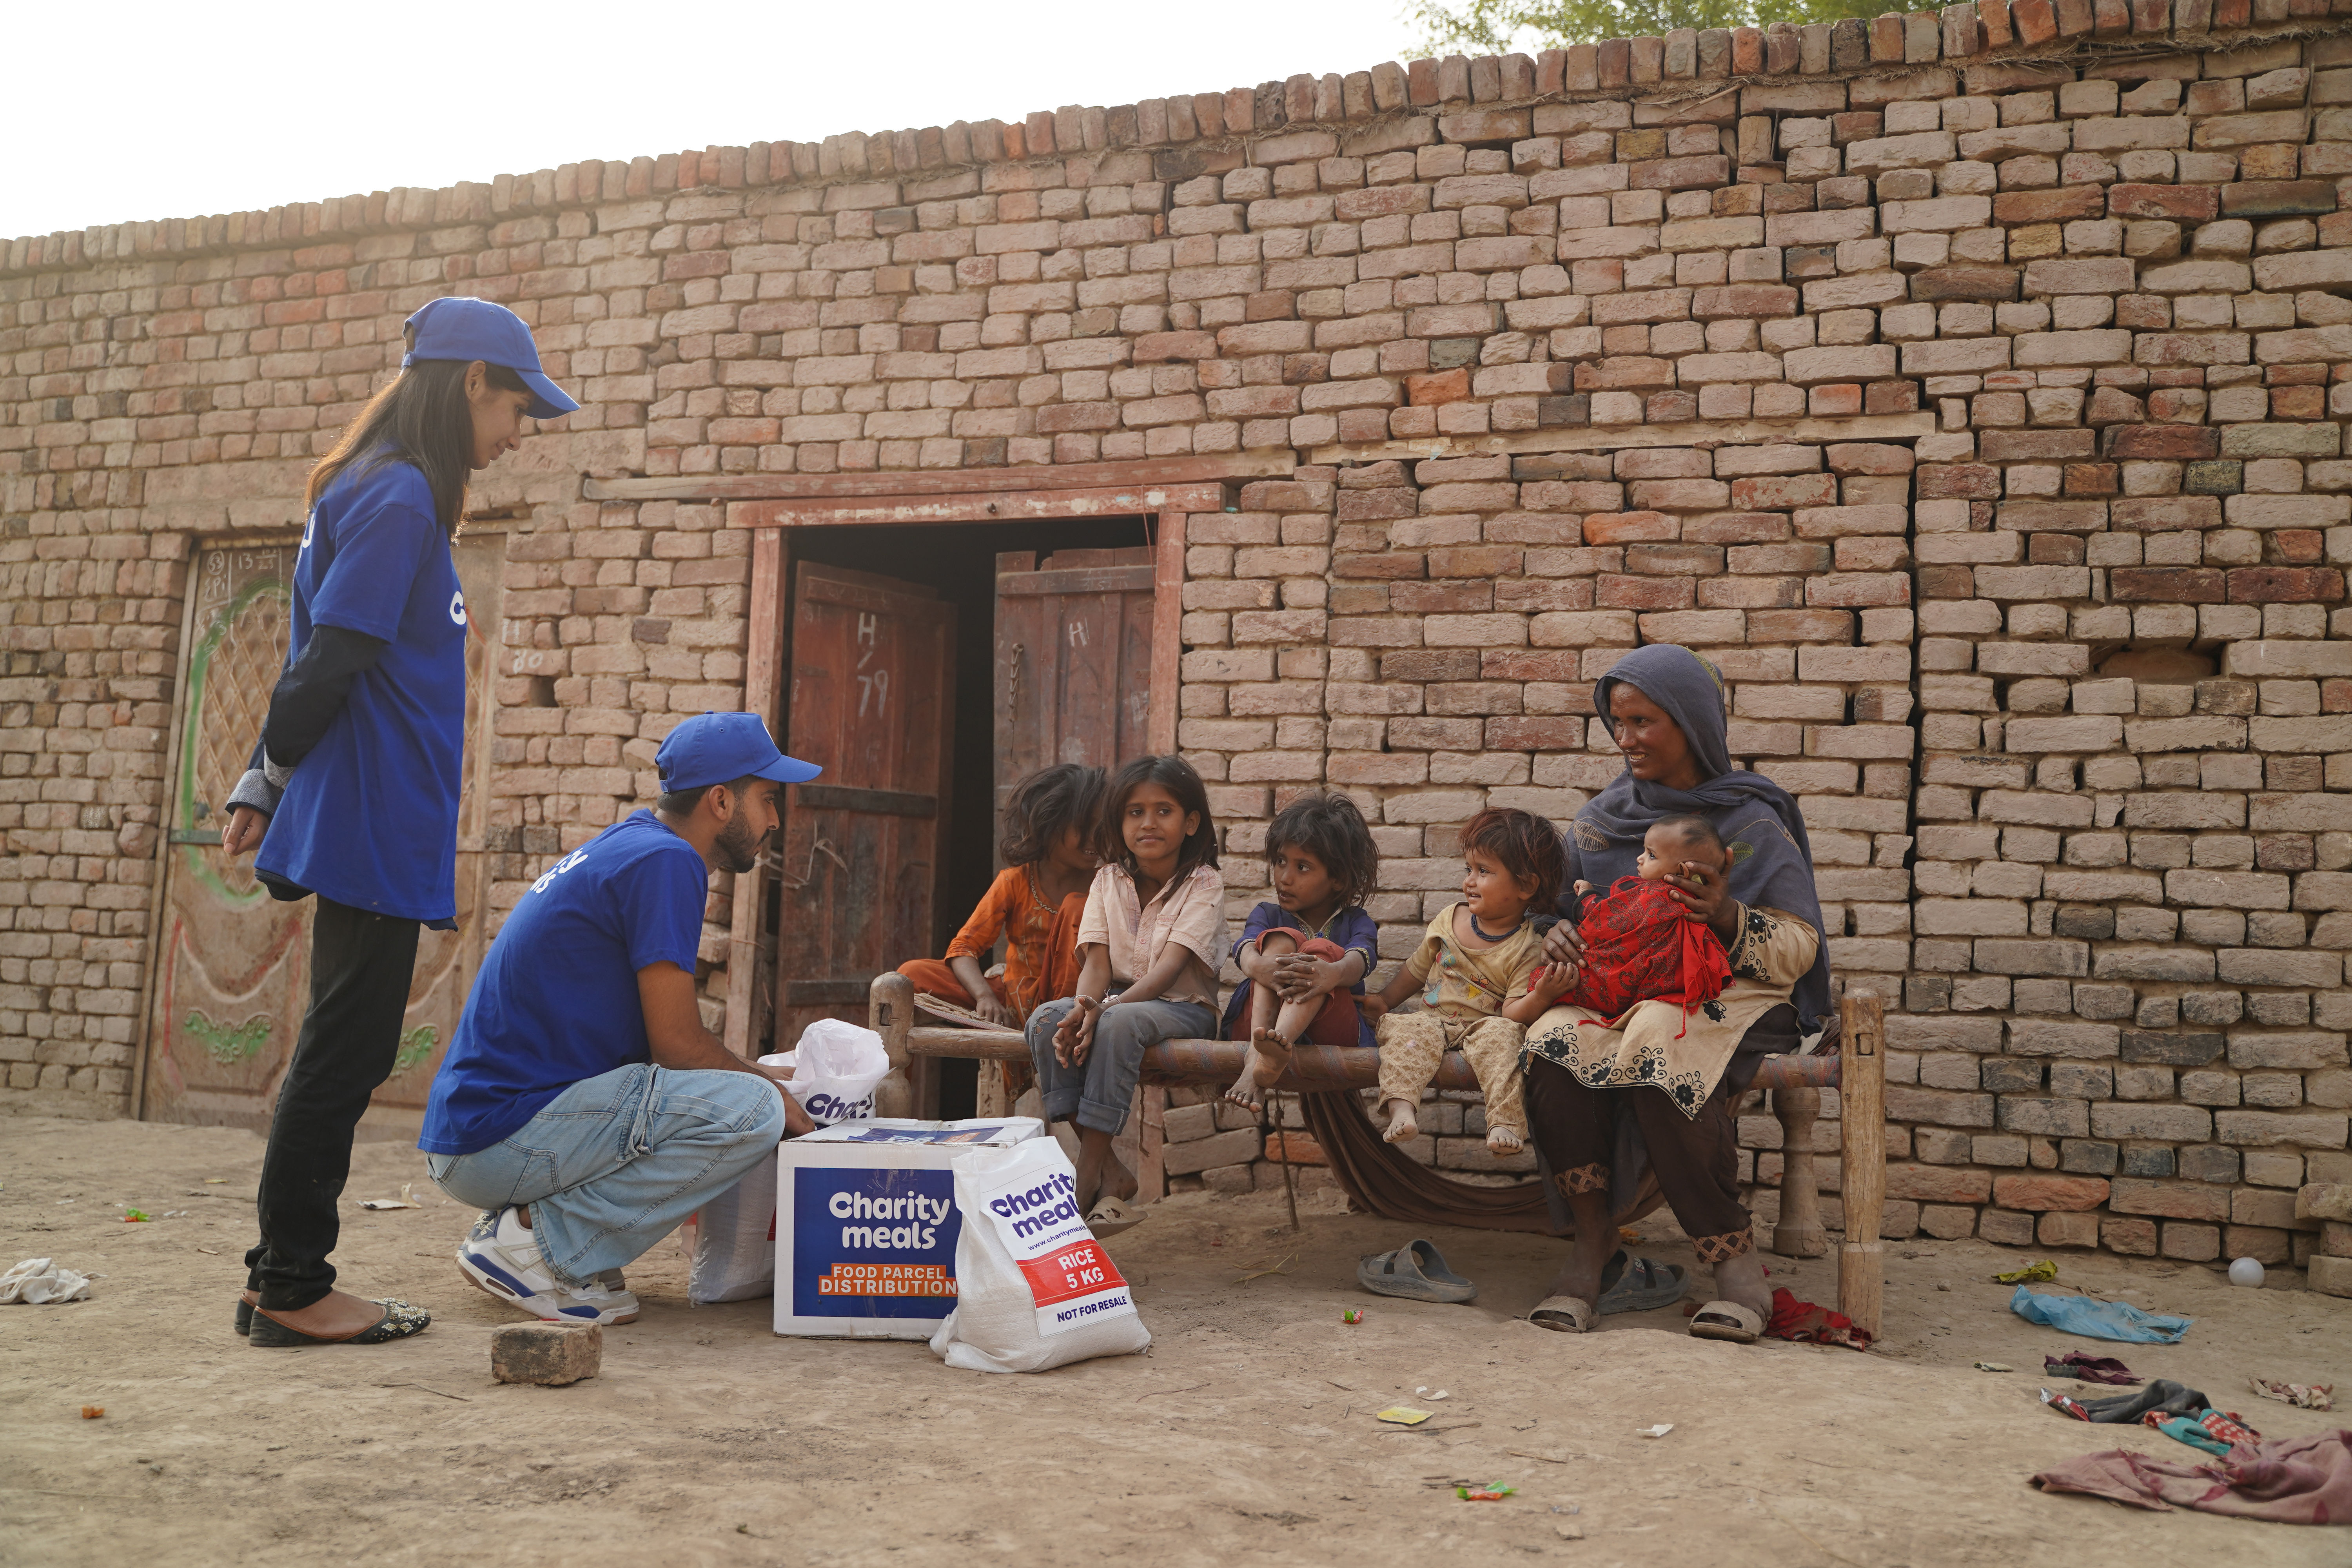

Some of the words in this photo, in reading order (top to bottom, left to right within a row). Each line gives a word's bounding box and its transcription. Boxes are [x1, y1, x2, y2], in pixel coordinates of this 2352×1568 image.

[238, 552, 253, 570] 13
[857, 612, 877, 646] H
[857, 670, 889, 719] 79
[829, 1191, 950, 1225] Charity
[990, 1173, 1074, 1218] Charit
[1012, 1194, 1079, 1238] meal
[842, 1221, 936, 1249] meals
[833, 1266, 877, 1278] FOOD
[883, 1267, 944, 1279] PARCEL
[1058, 1248, 1096, 1270] RICE
[821, 1279, 957, 1294] DISTRIBUTION
[1066, 1273, 1078, 1289] 5
[1080, 1267, 1104, 1285] KG
[1057, 1308, 1078, 1322] NOT
[1079, 1303, 1098, 1316] FOR
[1099, 1296, 1127, 1312] RESALE
